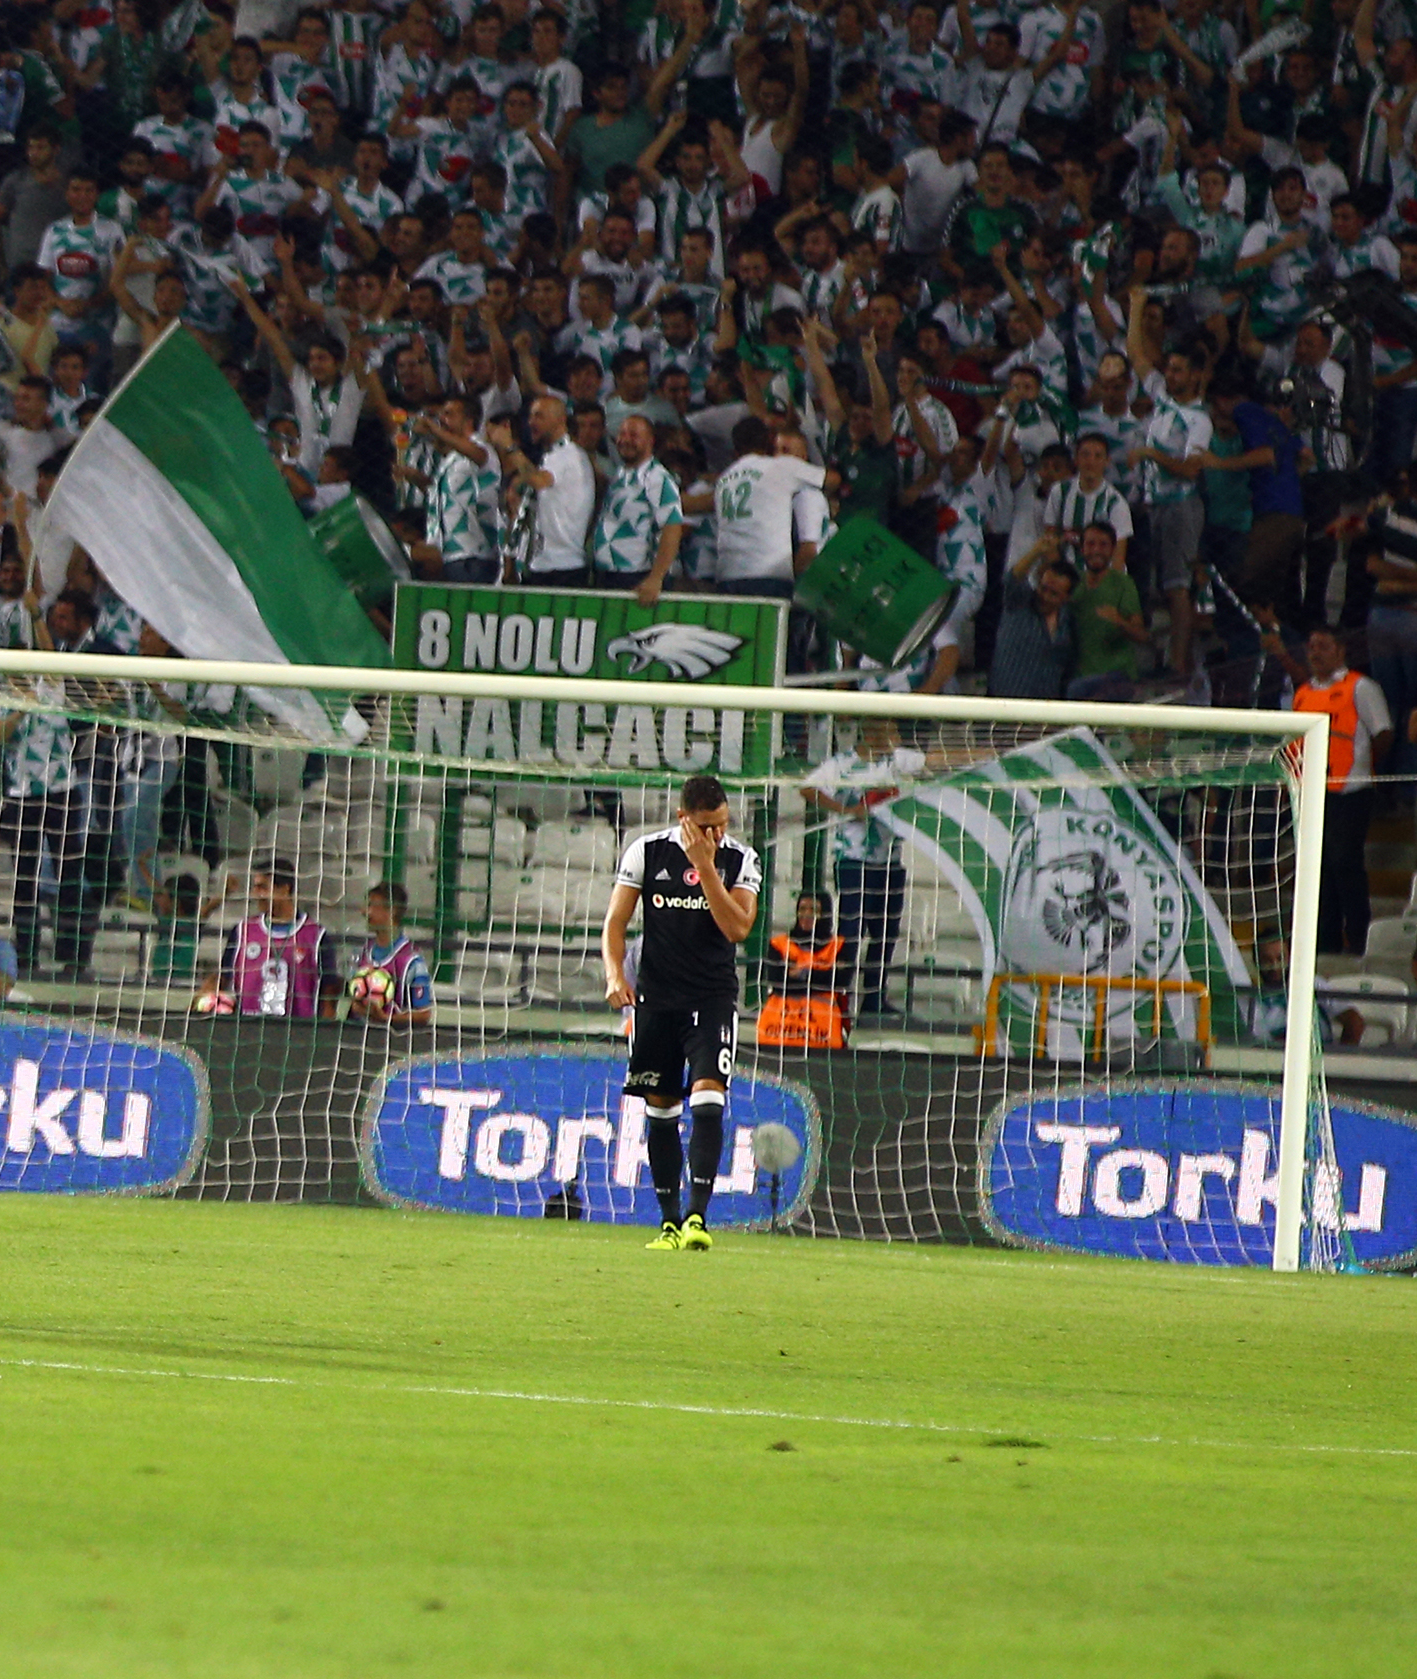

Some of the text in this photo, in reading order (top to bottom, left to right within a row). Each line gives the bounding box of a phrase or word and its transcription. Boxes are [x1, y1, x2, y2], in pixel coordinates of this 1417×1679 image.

[722, 481, 753, 521] 42
[418, 609, 598, 676] 8 NOLU
[665, 894, 711, 911] vodafo
[718, 1047, 732, 1076] 6
[418, 1087, 756, 1195] Torku
[1035, 1121, 1387, 1233] Torku
